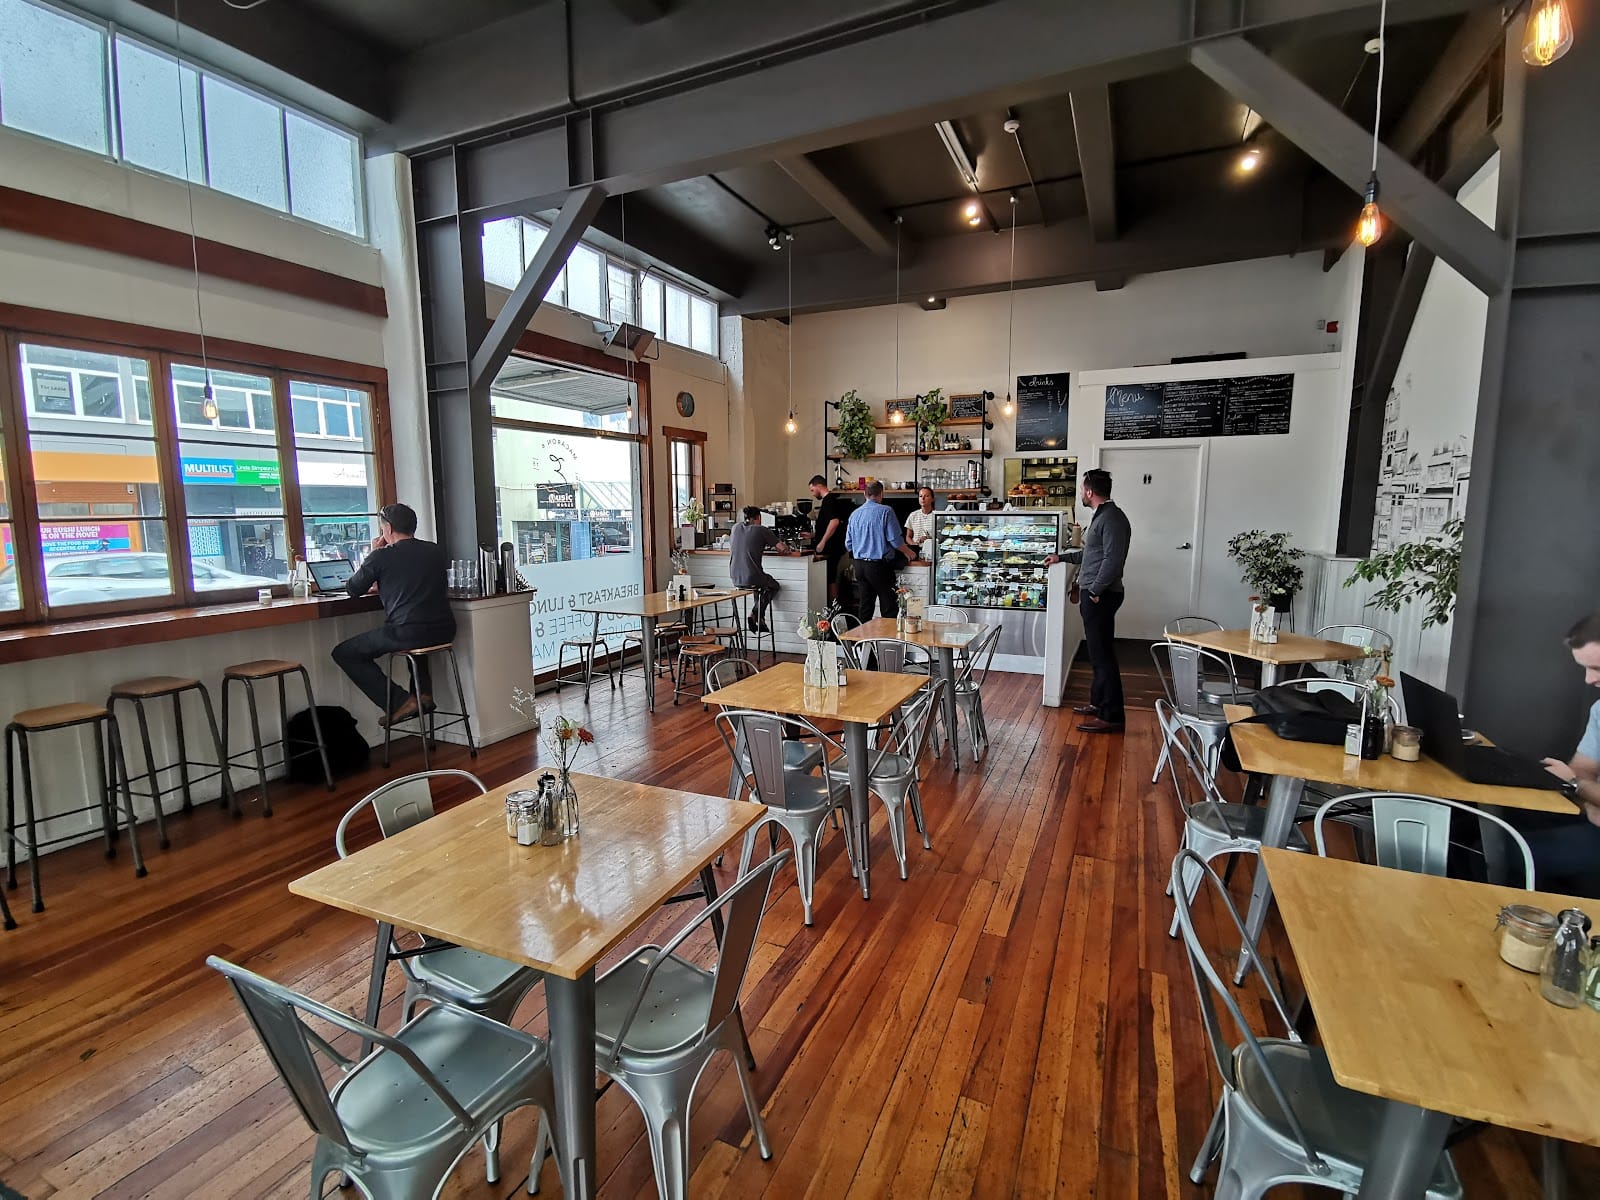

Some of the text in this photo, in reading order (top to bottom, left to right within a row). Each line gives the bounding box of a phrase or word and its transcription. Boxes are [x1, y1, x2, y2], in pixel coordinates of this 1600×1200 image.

[1029, 377, 1054, 387] drinks
[1107, 387, 1144, 406] Menu
[184, 463, 233, 473] MULTILIST
